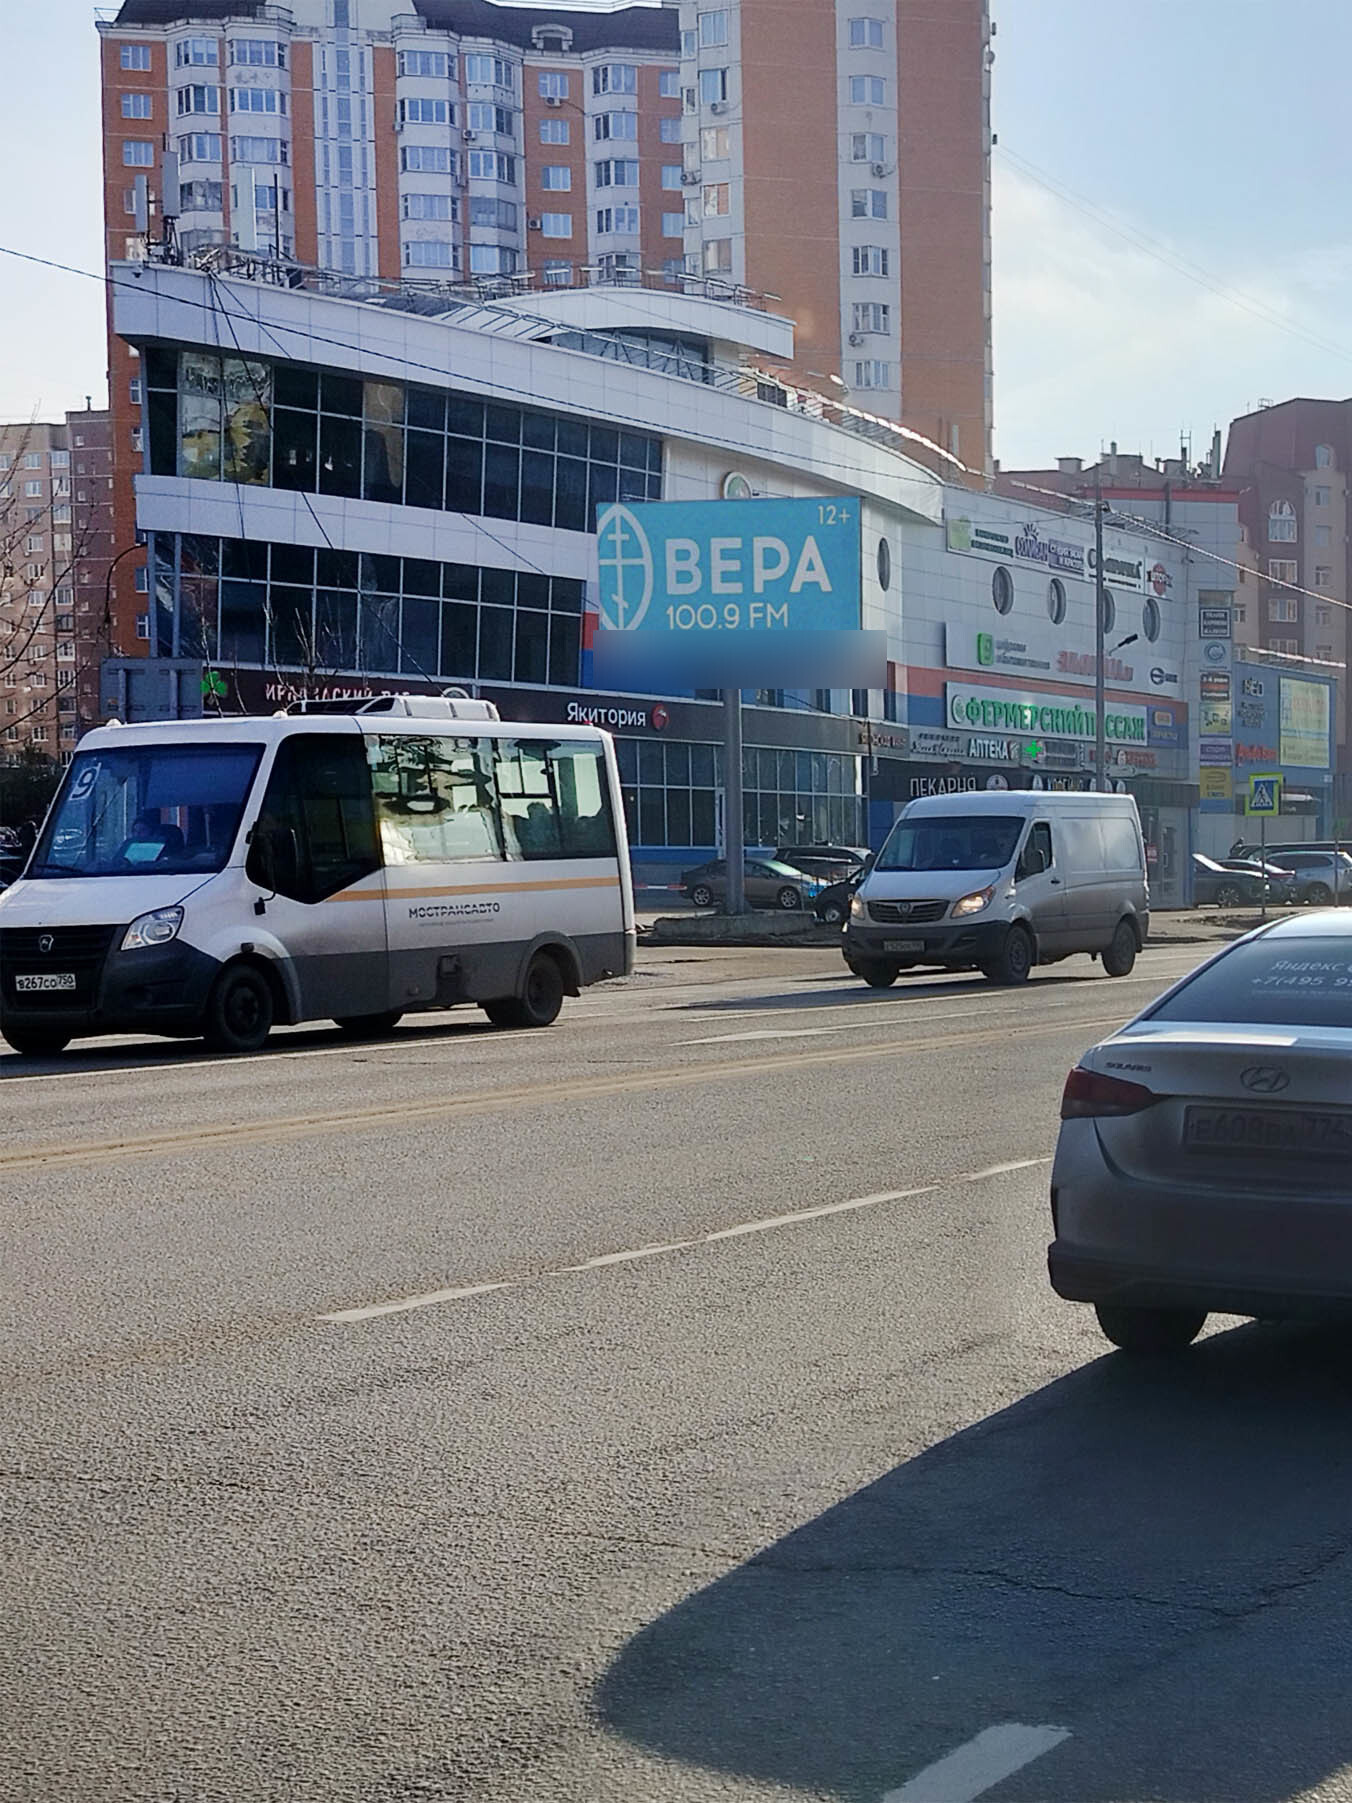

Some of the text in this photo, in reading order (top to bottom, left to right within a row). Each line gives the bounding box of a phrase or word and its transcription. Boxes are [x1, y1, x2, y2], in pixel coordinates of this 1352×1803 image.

[817, 505, 851, 525] 12+
[665, 535, 833, 595] ВЕРА
[666, 603, 789, 630] 100.9 FM
[567, 702, 647, 728] Якитория
[966, 697, 1146, 740] ФЕРМЕРСКИЙ ПССАЖ
[969, 738, 1009, 760] АПТЕКА
[71, 766, 97, 799] 9
[910, 776, 976, 797] ПЕКАРНЯ
[409, 902, 501, 918] МОСТРАНСАВТО
